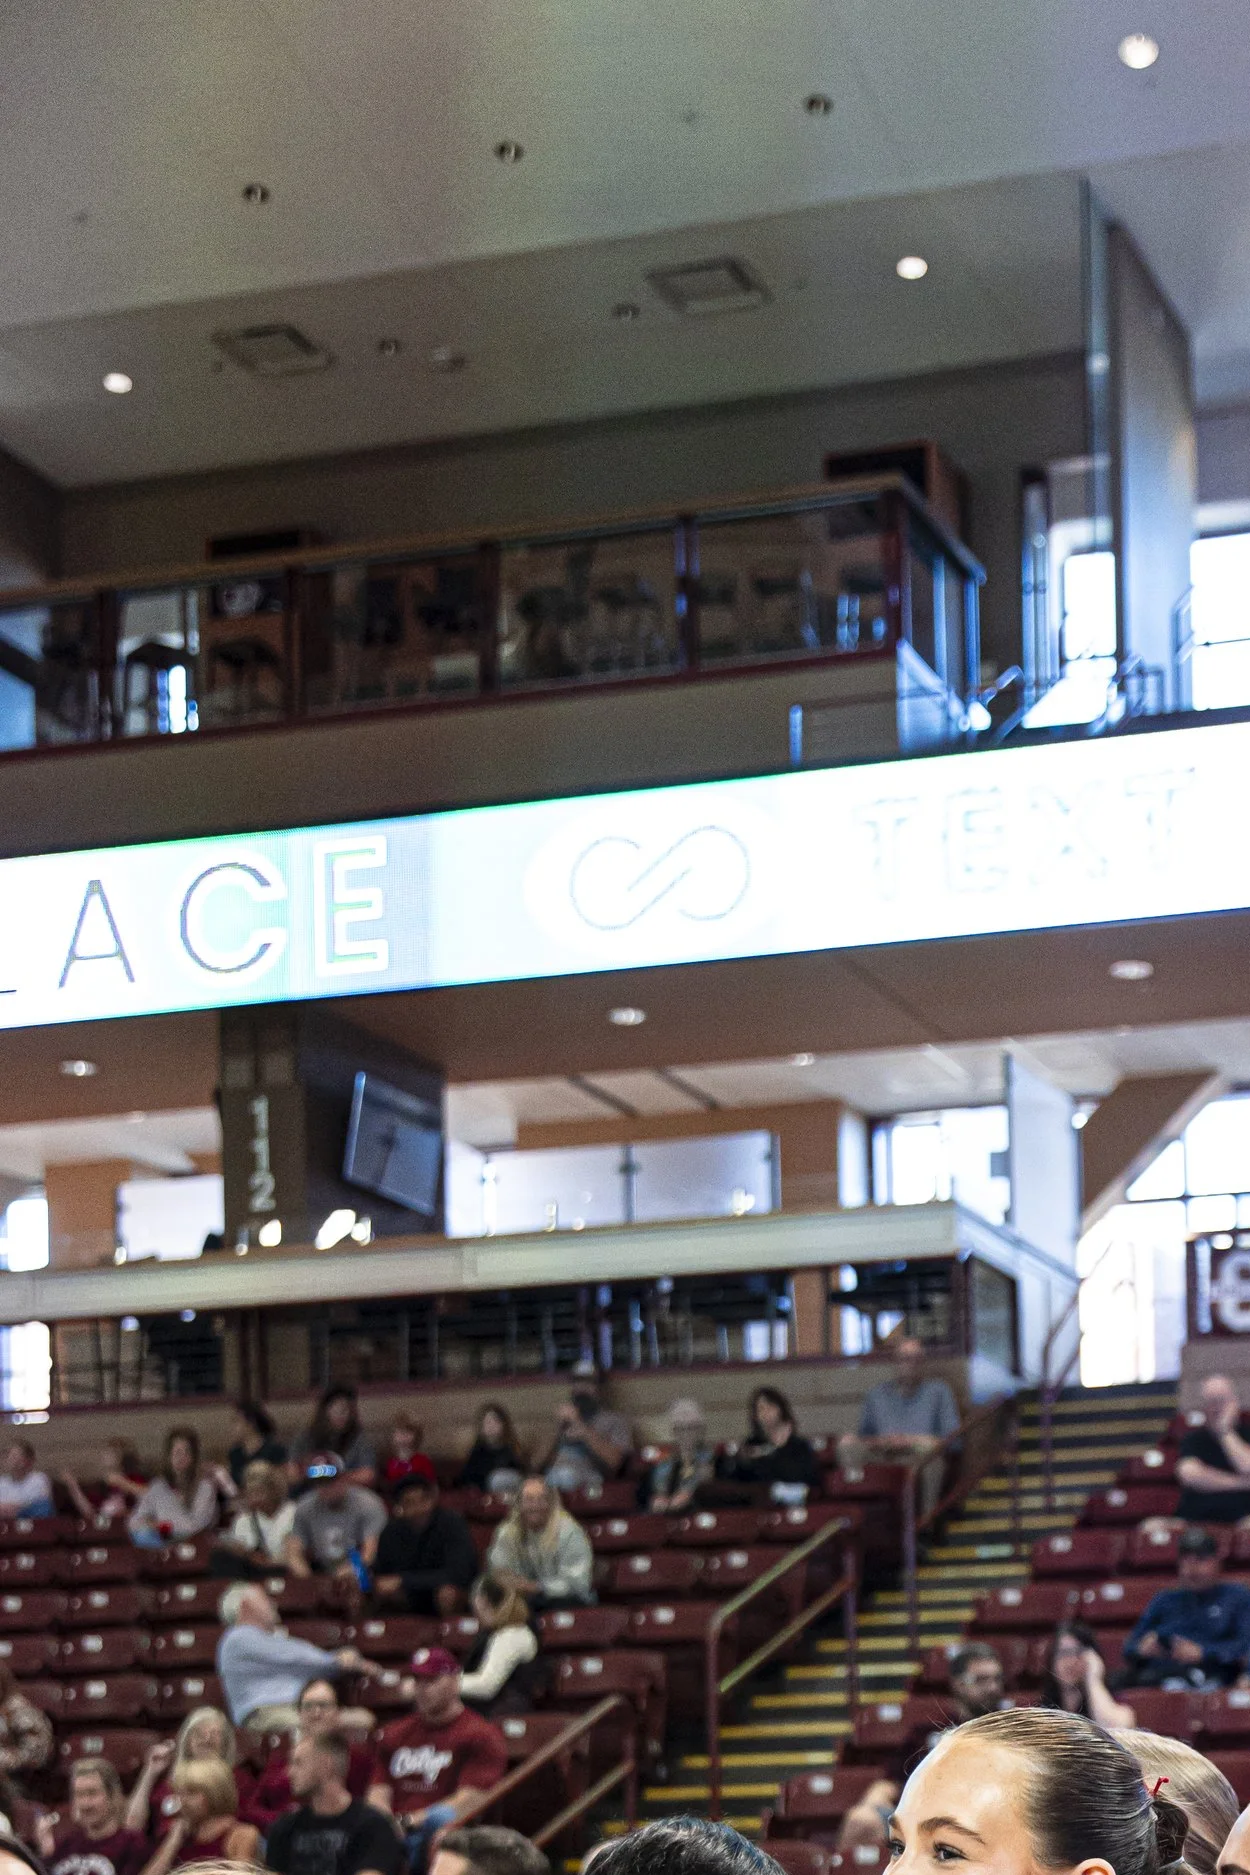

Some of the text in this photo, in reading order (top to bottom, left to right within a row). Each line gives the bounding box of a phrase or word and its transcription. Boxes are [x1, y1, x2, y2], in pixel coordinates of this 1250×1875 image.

[0, 835, 389, 993] ACE
[852, 767, 1196, 900] TEXT
[251, 1095, 276, 1212] 112
